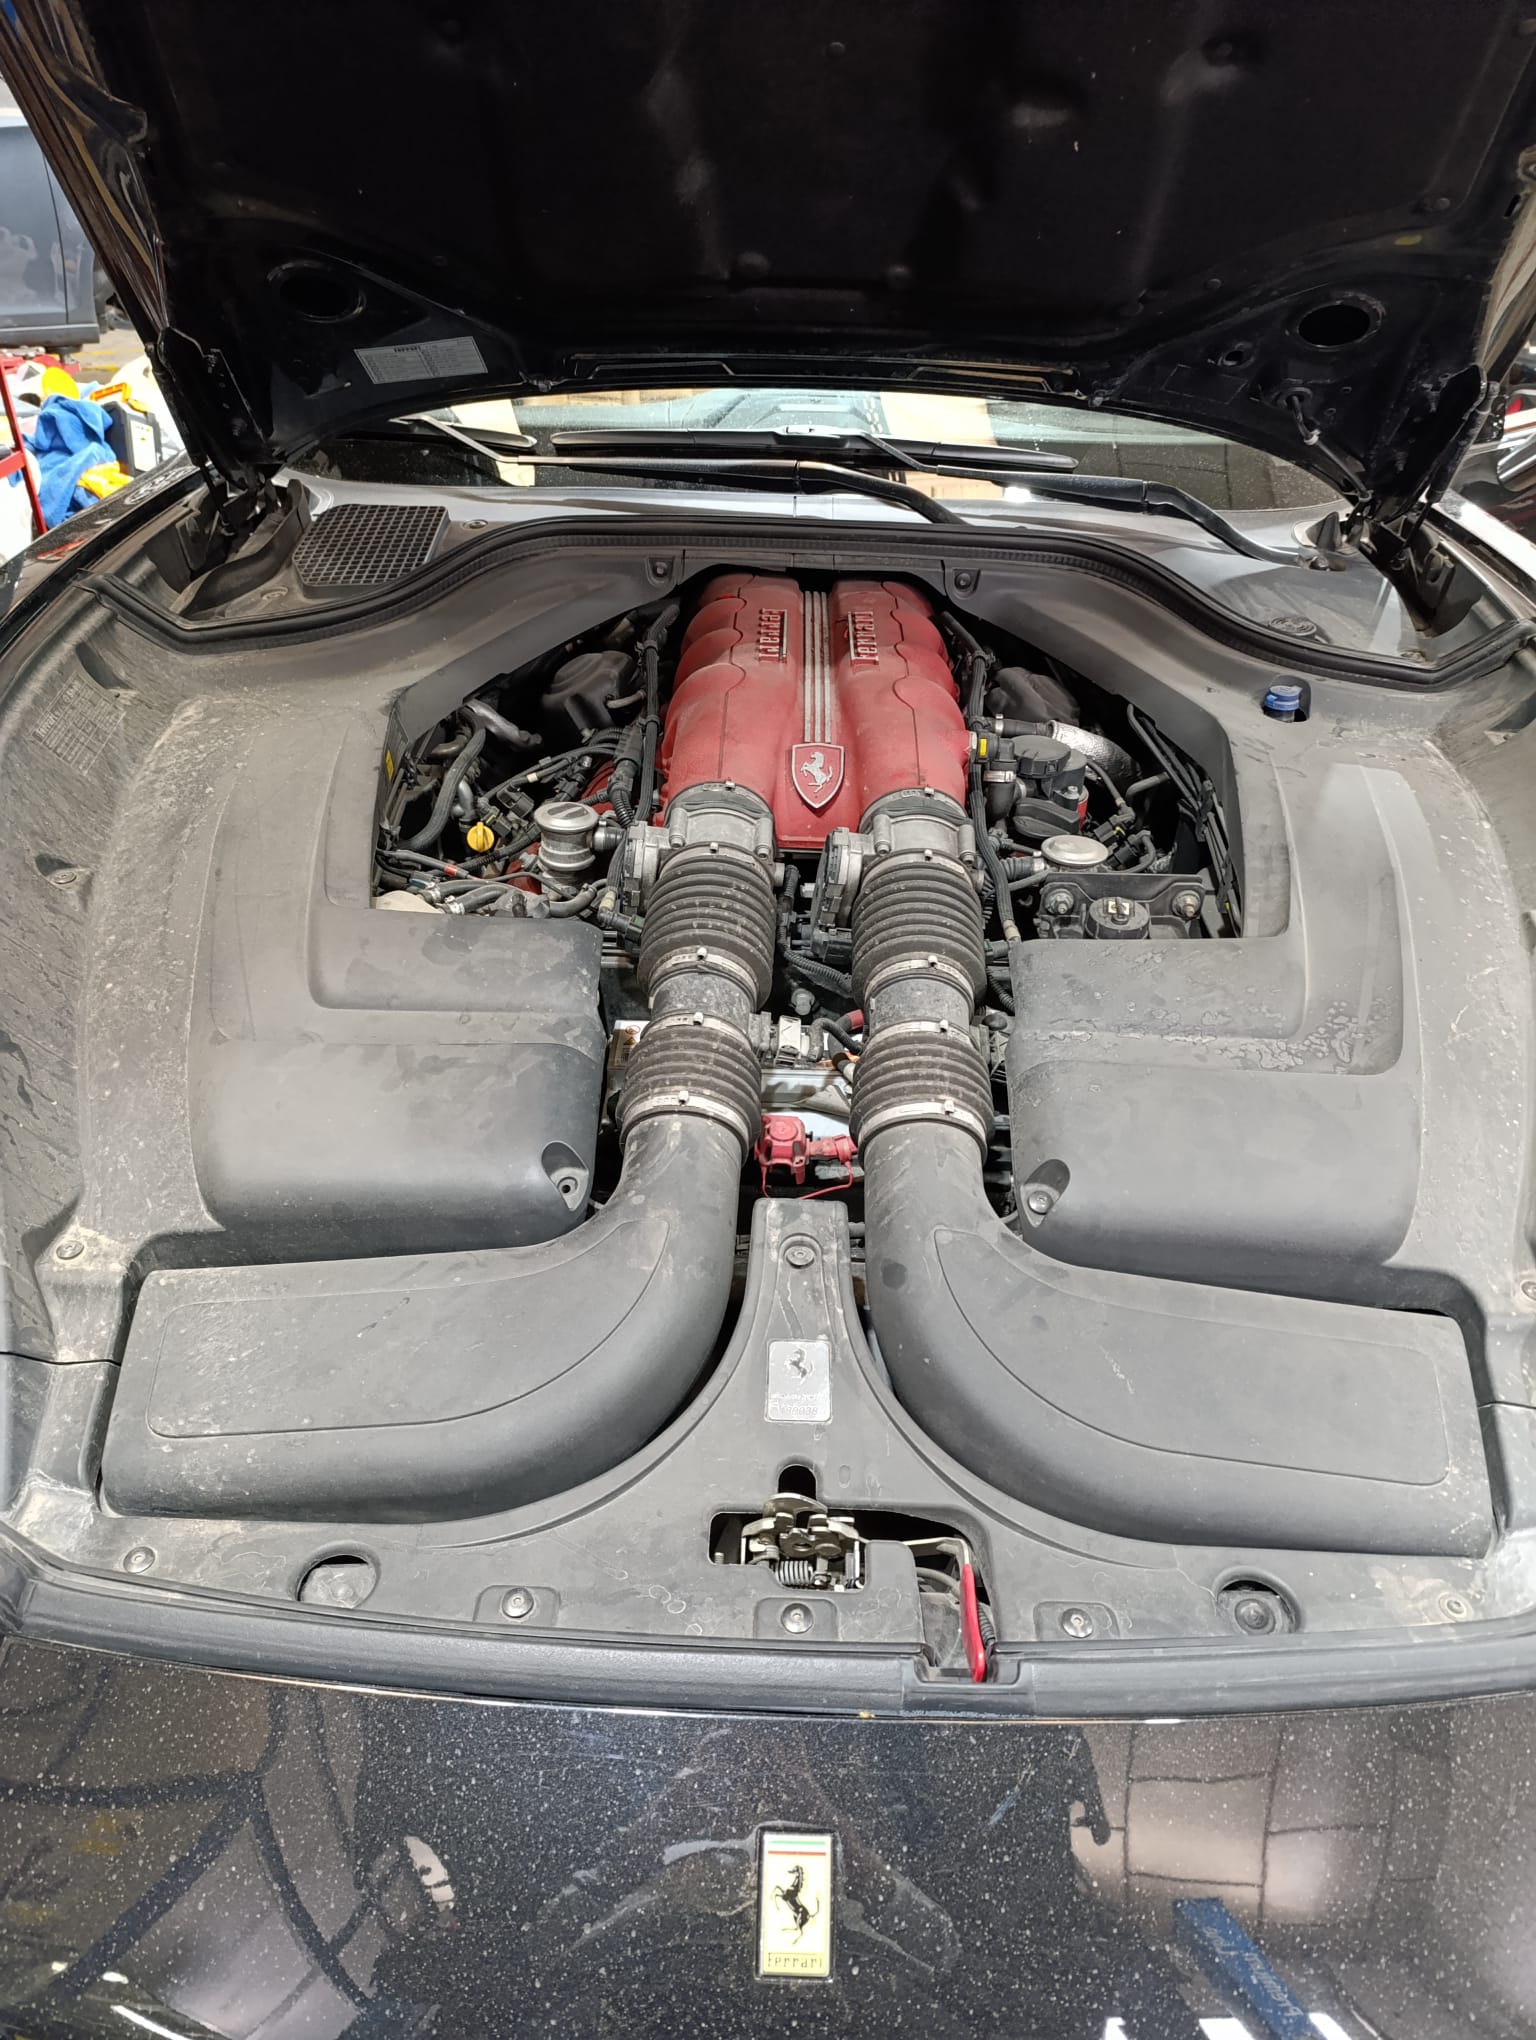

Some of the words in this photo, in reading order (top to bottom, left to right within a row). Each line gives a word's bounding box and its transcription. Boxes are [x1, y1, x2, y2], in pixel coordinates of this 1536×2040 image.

[758, 607, 788, 659] Ferrari
[847, 611, 880, 661] Ferrari
[768, 1952, 823, 1969] Ferrari
